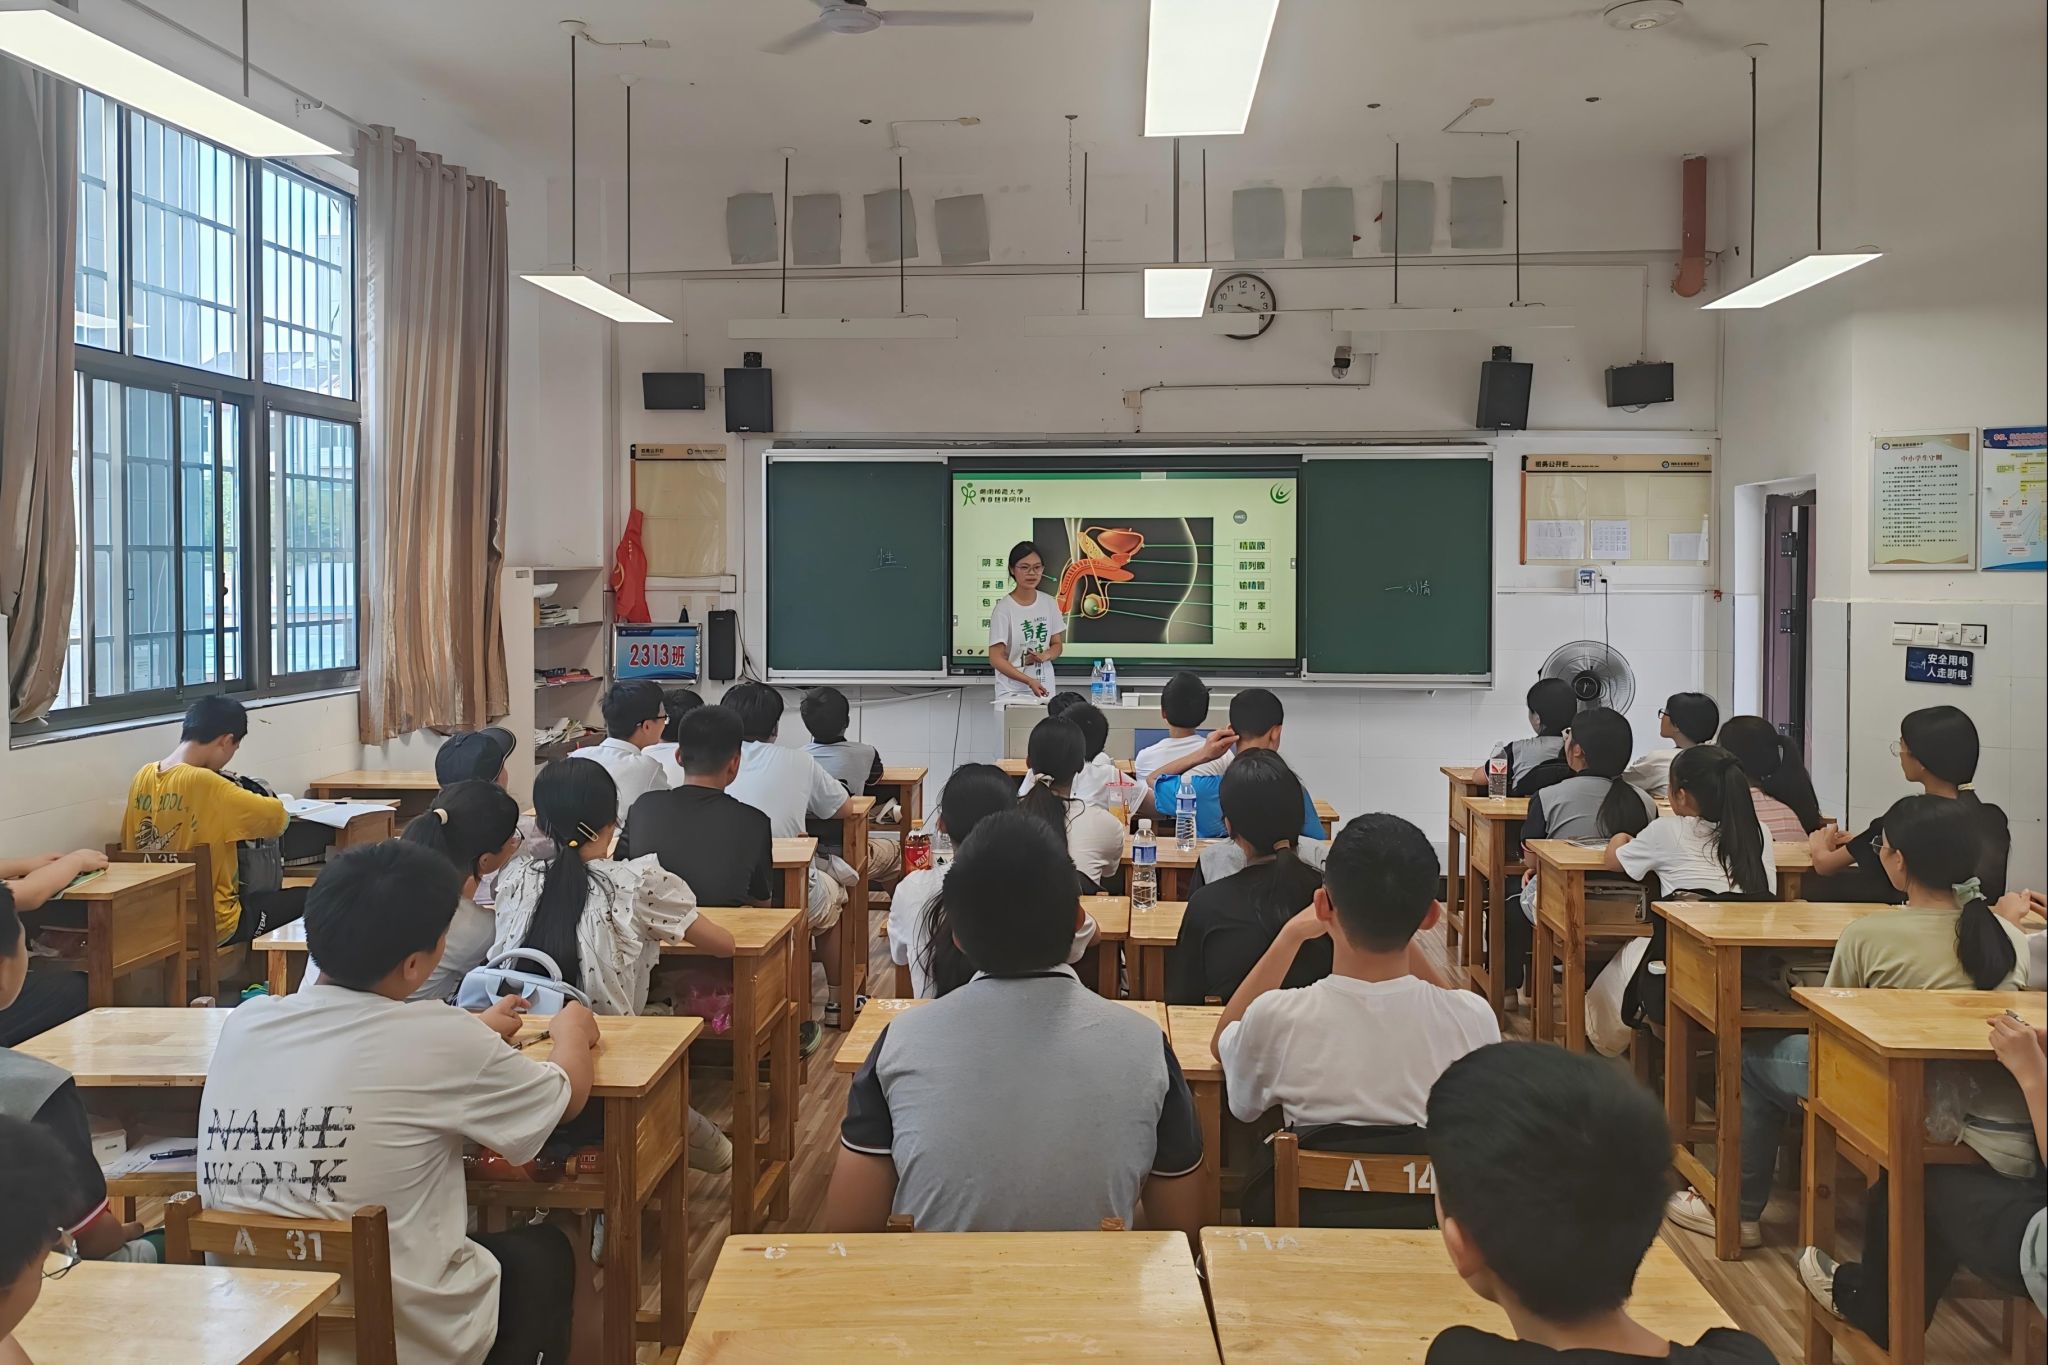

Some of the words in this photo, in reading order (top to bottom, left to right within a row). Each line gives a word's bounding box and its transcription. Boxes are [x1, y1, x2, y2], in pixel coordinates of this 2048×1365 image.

[1239, 280, 1248, 289] 12
[1260, 291, 1266, 299] 2
[1217, 304, 1223, 312] 9
[1262, 302, 1268, 310] 3
[1239, 561, 1266, 570] 前列腺
[629, 643, 686, 668] 2313班
[1927, 653, 1969, 667] 安全用电
[1926, 666, 1968, 680] 人走断电
[207, 1105, 355, 1151] NAME
[203, 1159, 348, 1205] WORK
[1343, 1159, 1371, 1192] A
[233, 1226, 257, 1256] A
[285, 1228, 323, 1262] 31
